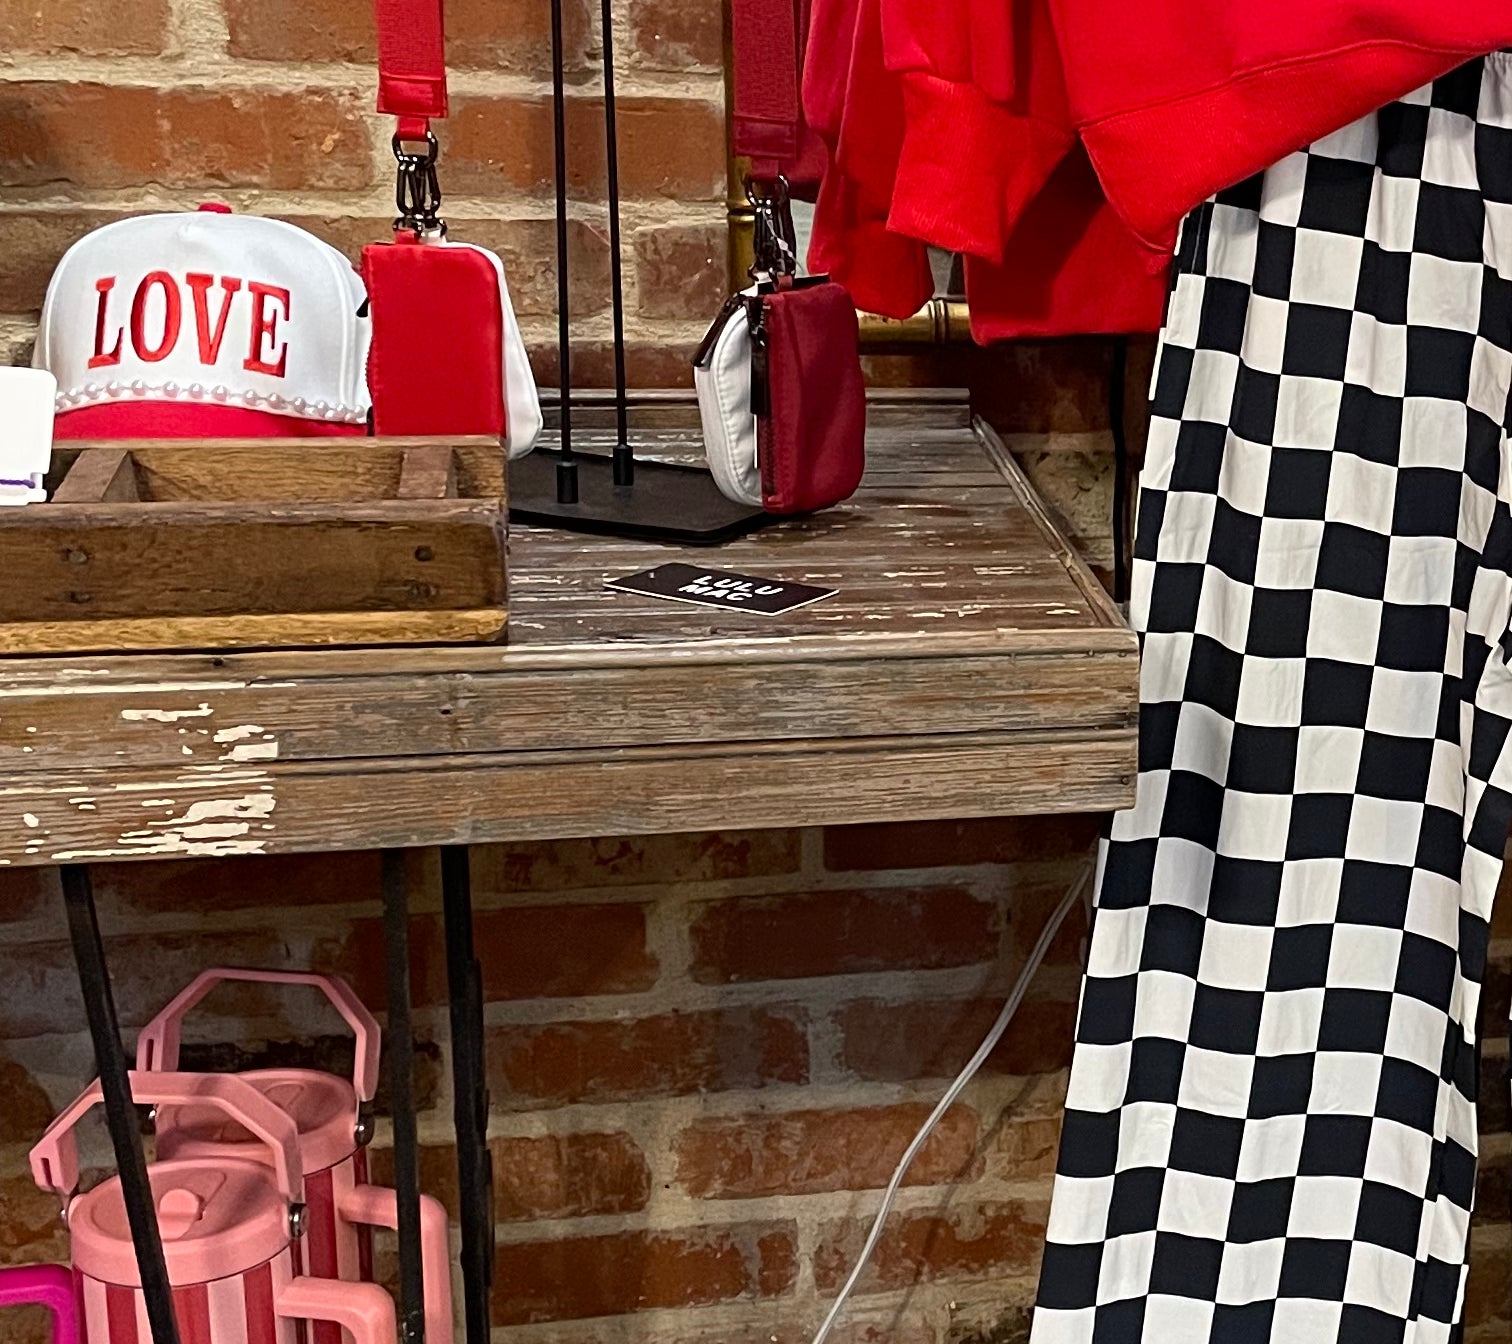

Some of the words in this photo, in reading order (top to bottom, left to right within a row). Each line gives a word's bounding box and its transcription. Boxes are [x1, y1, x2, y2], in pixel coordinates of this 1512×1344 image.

[88, 270, 290, 379] LOVE
[678, 584, 753, 601] MAC
[692, 575, 784, 595] LULU
